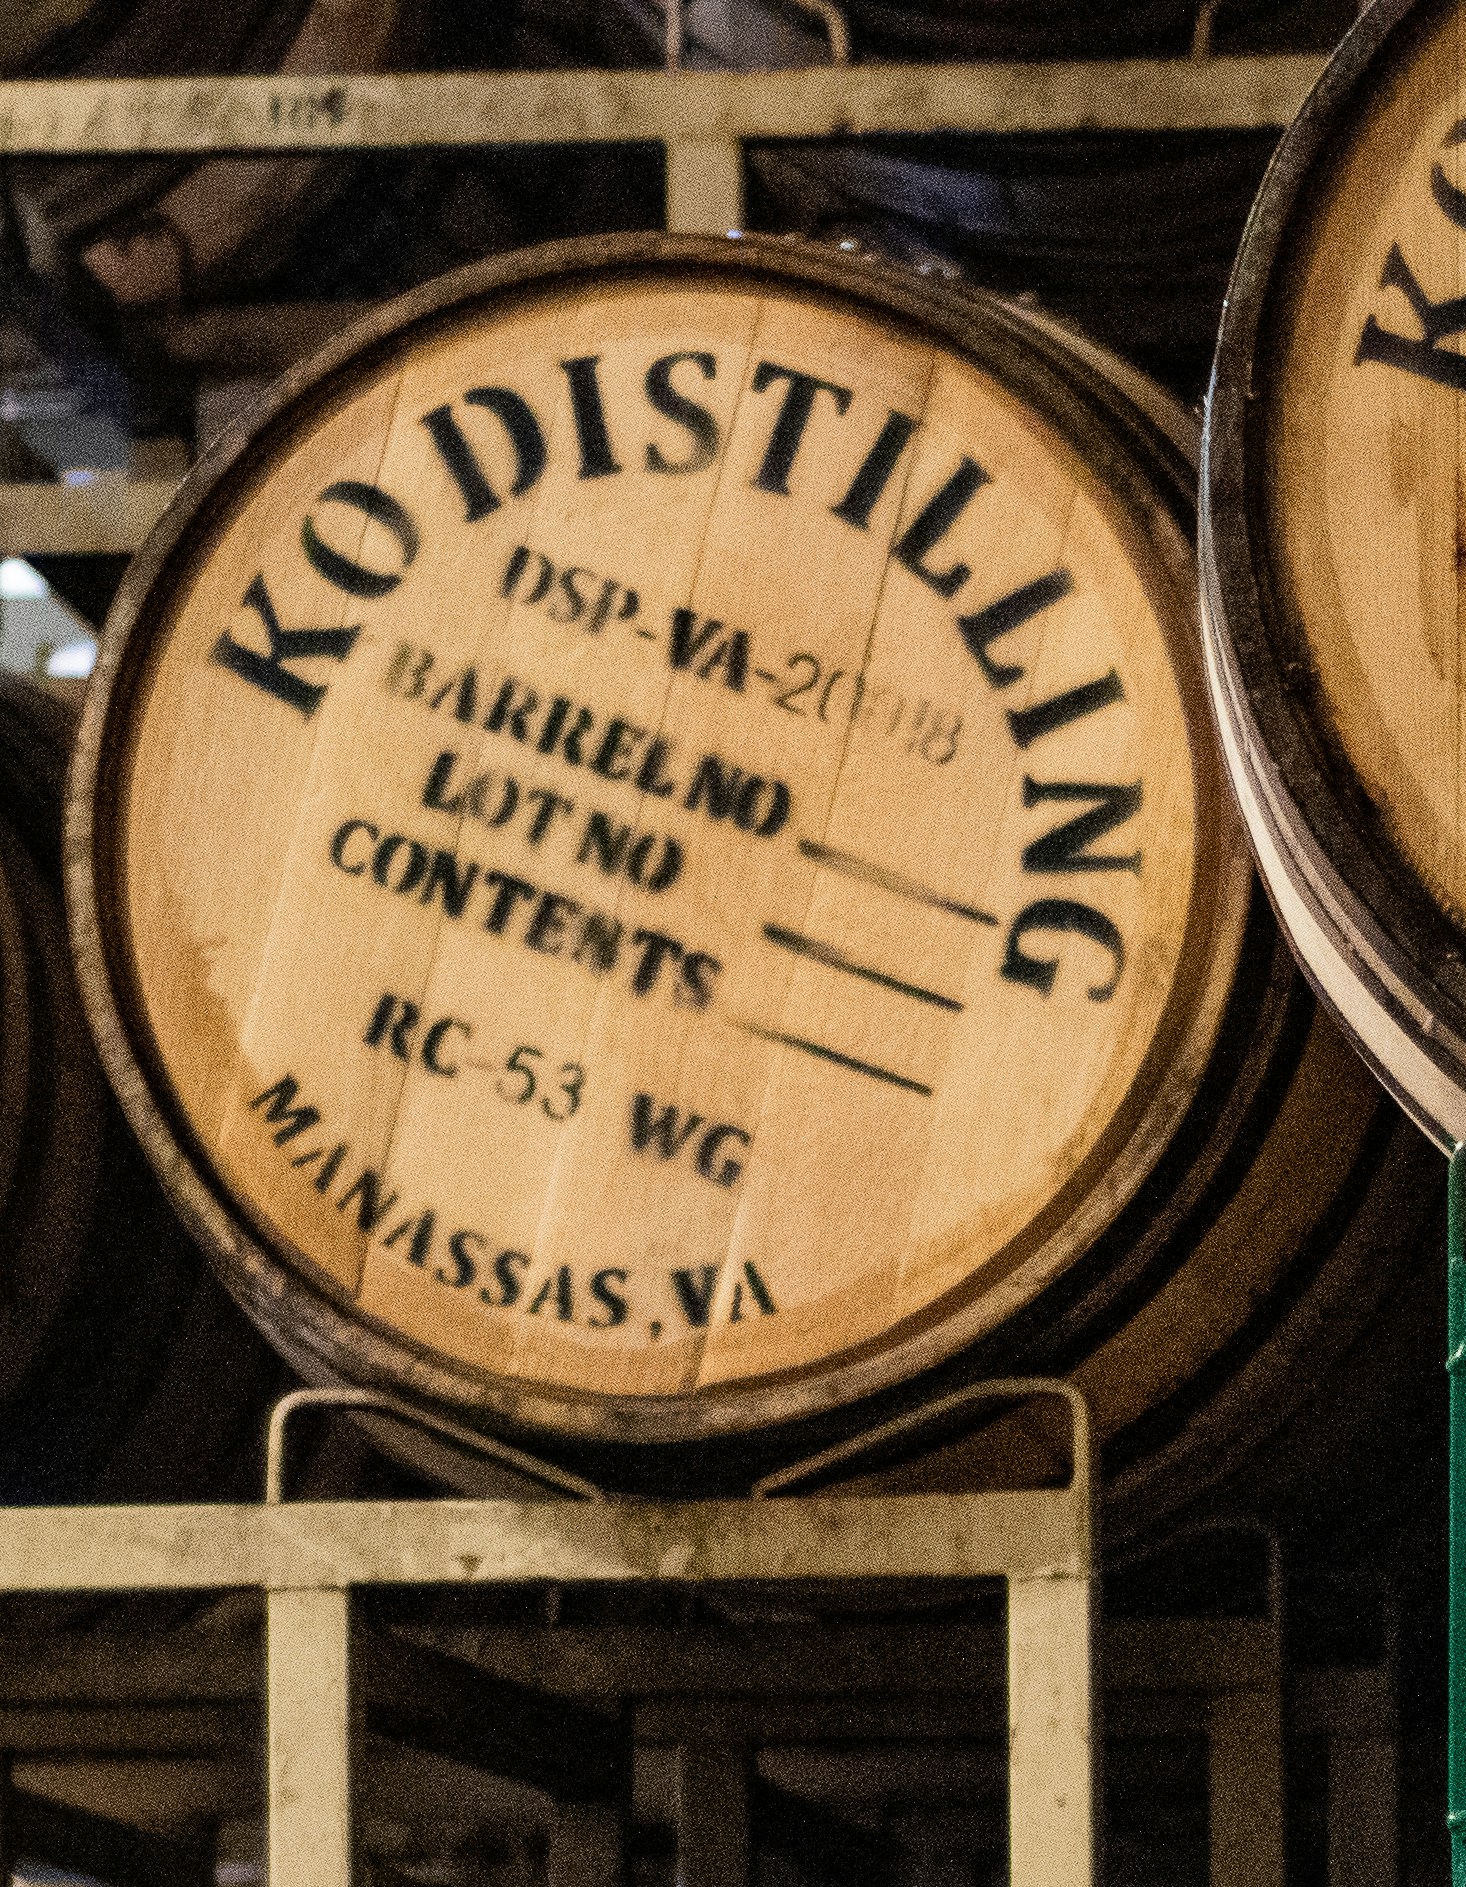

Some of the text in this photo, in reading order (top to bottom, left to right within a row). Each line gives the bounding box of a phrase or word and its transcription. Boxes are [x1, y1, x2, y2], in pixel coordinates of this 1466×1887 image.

[213, 349, 1145, 1005] KO DISTILLING
[384, 639, 793, 842] BARREL NO
[328, 816, 723, 1009] CONTENTS
[420, 750, 685, 895] LOT NO
[363, 991, 752, 1190] RC-53 WG
[669, 1257, 782, 1331] VA
